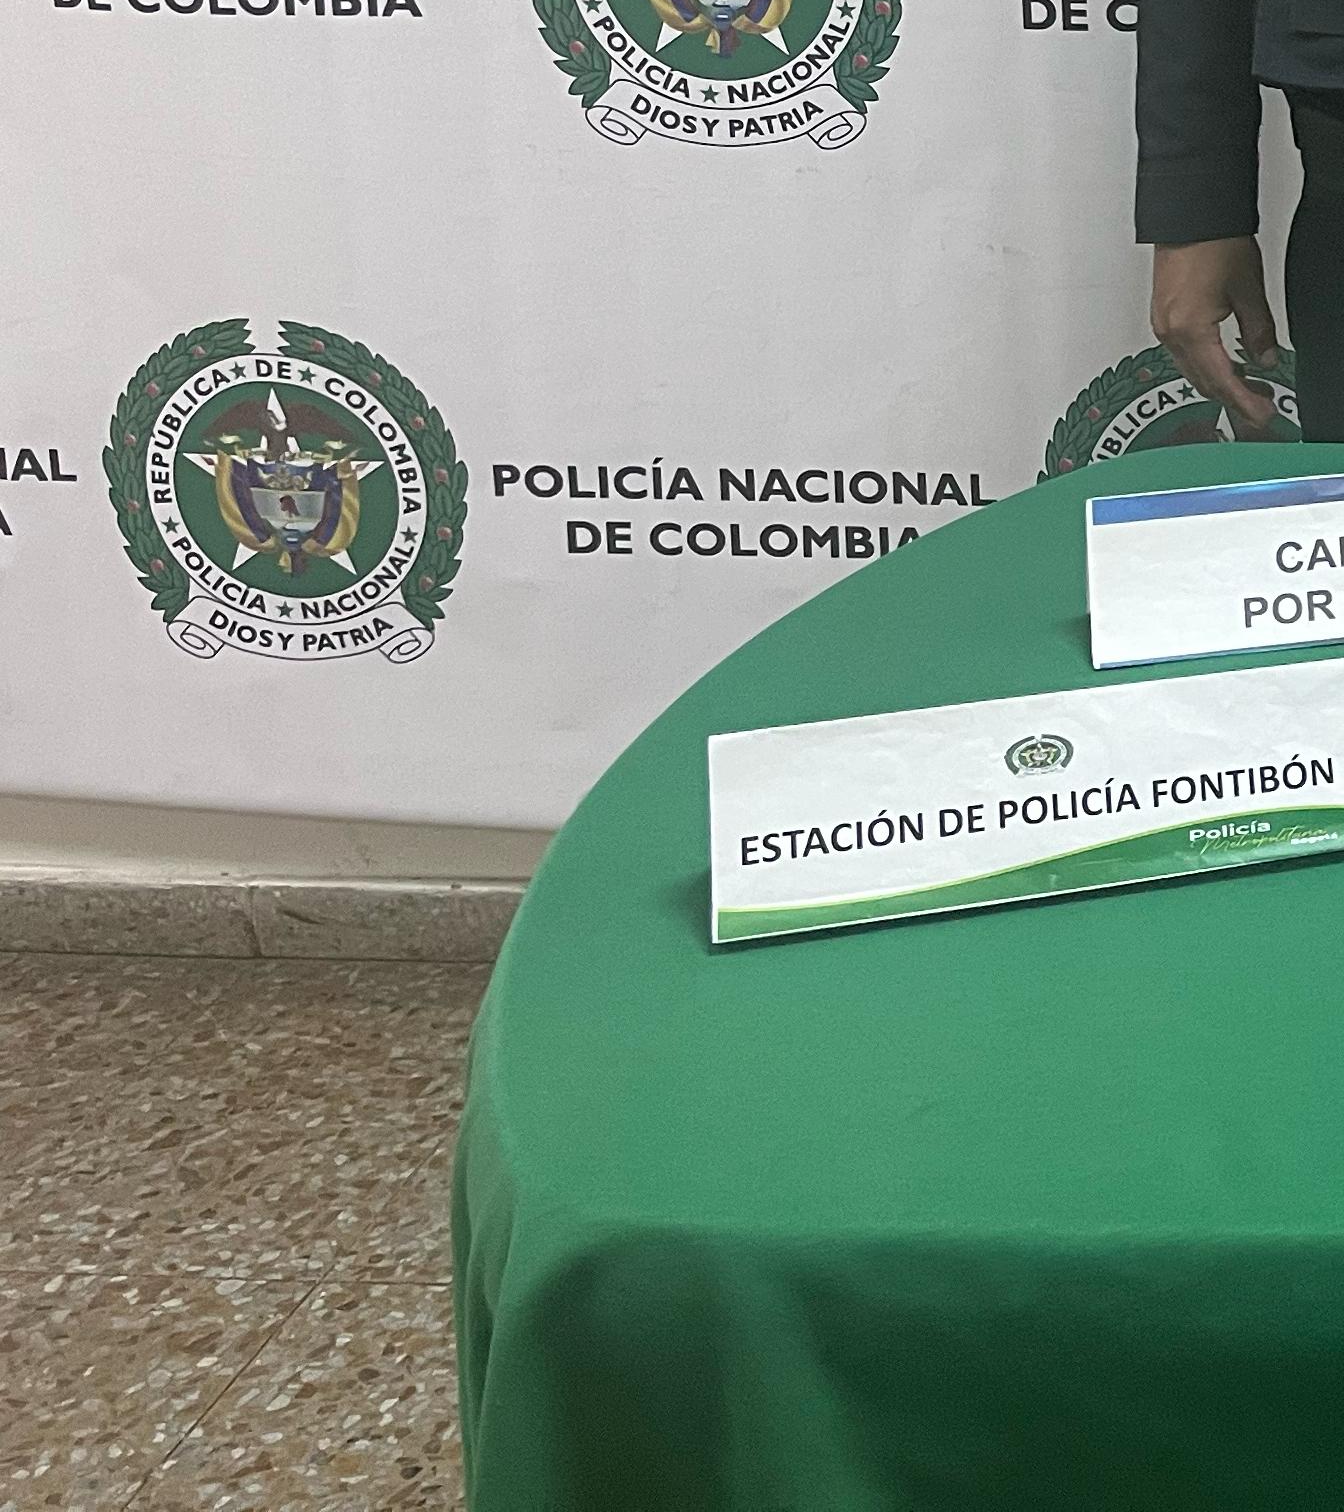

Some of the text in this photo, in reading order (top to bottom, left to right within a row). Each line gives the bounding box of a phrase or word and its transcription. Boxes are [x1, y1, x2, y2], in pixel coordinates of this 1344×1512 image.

[727, 21, 851, 104] NACIONAL
[728, 99, 823, 139] PATRIA
[257, 358, 296, 379] DE
[327, 376, 422, 515] COLOMBIA
[493, 457, 997, 507] POLICÍA NACIONAL
[567, 521, 632, 554] DE
[299, 545, 414, 621] NACIONAL
[1244, 590, 1335, 628] POR
[301, 618, 391, 653] PATRIA
[742, 754, 1333, 865] ESTACIÓN DE POLICÍA FONTIBÓN
[1190, 820, 1271, 842] Policía
